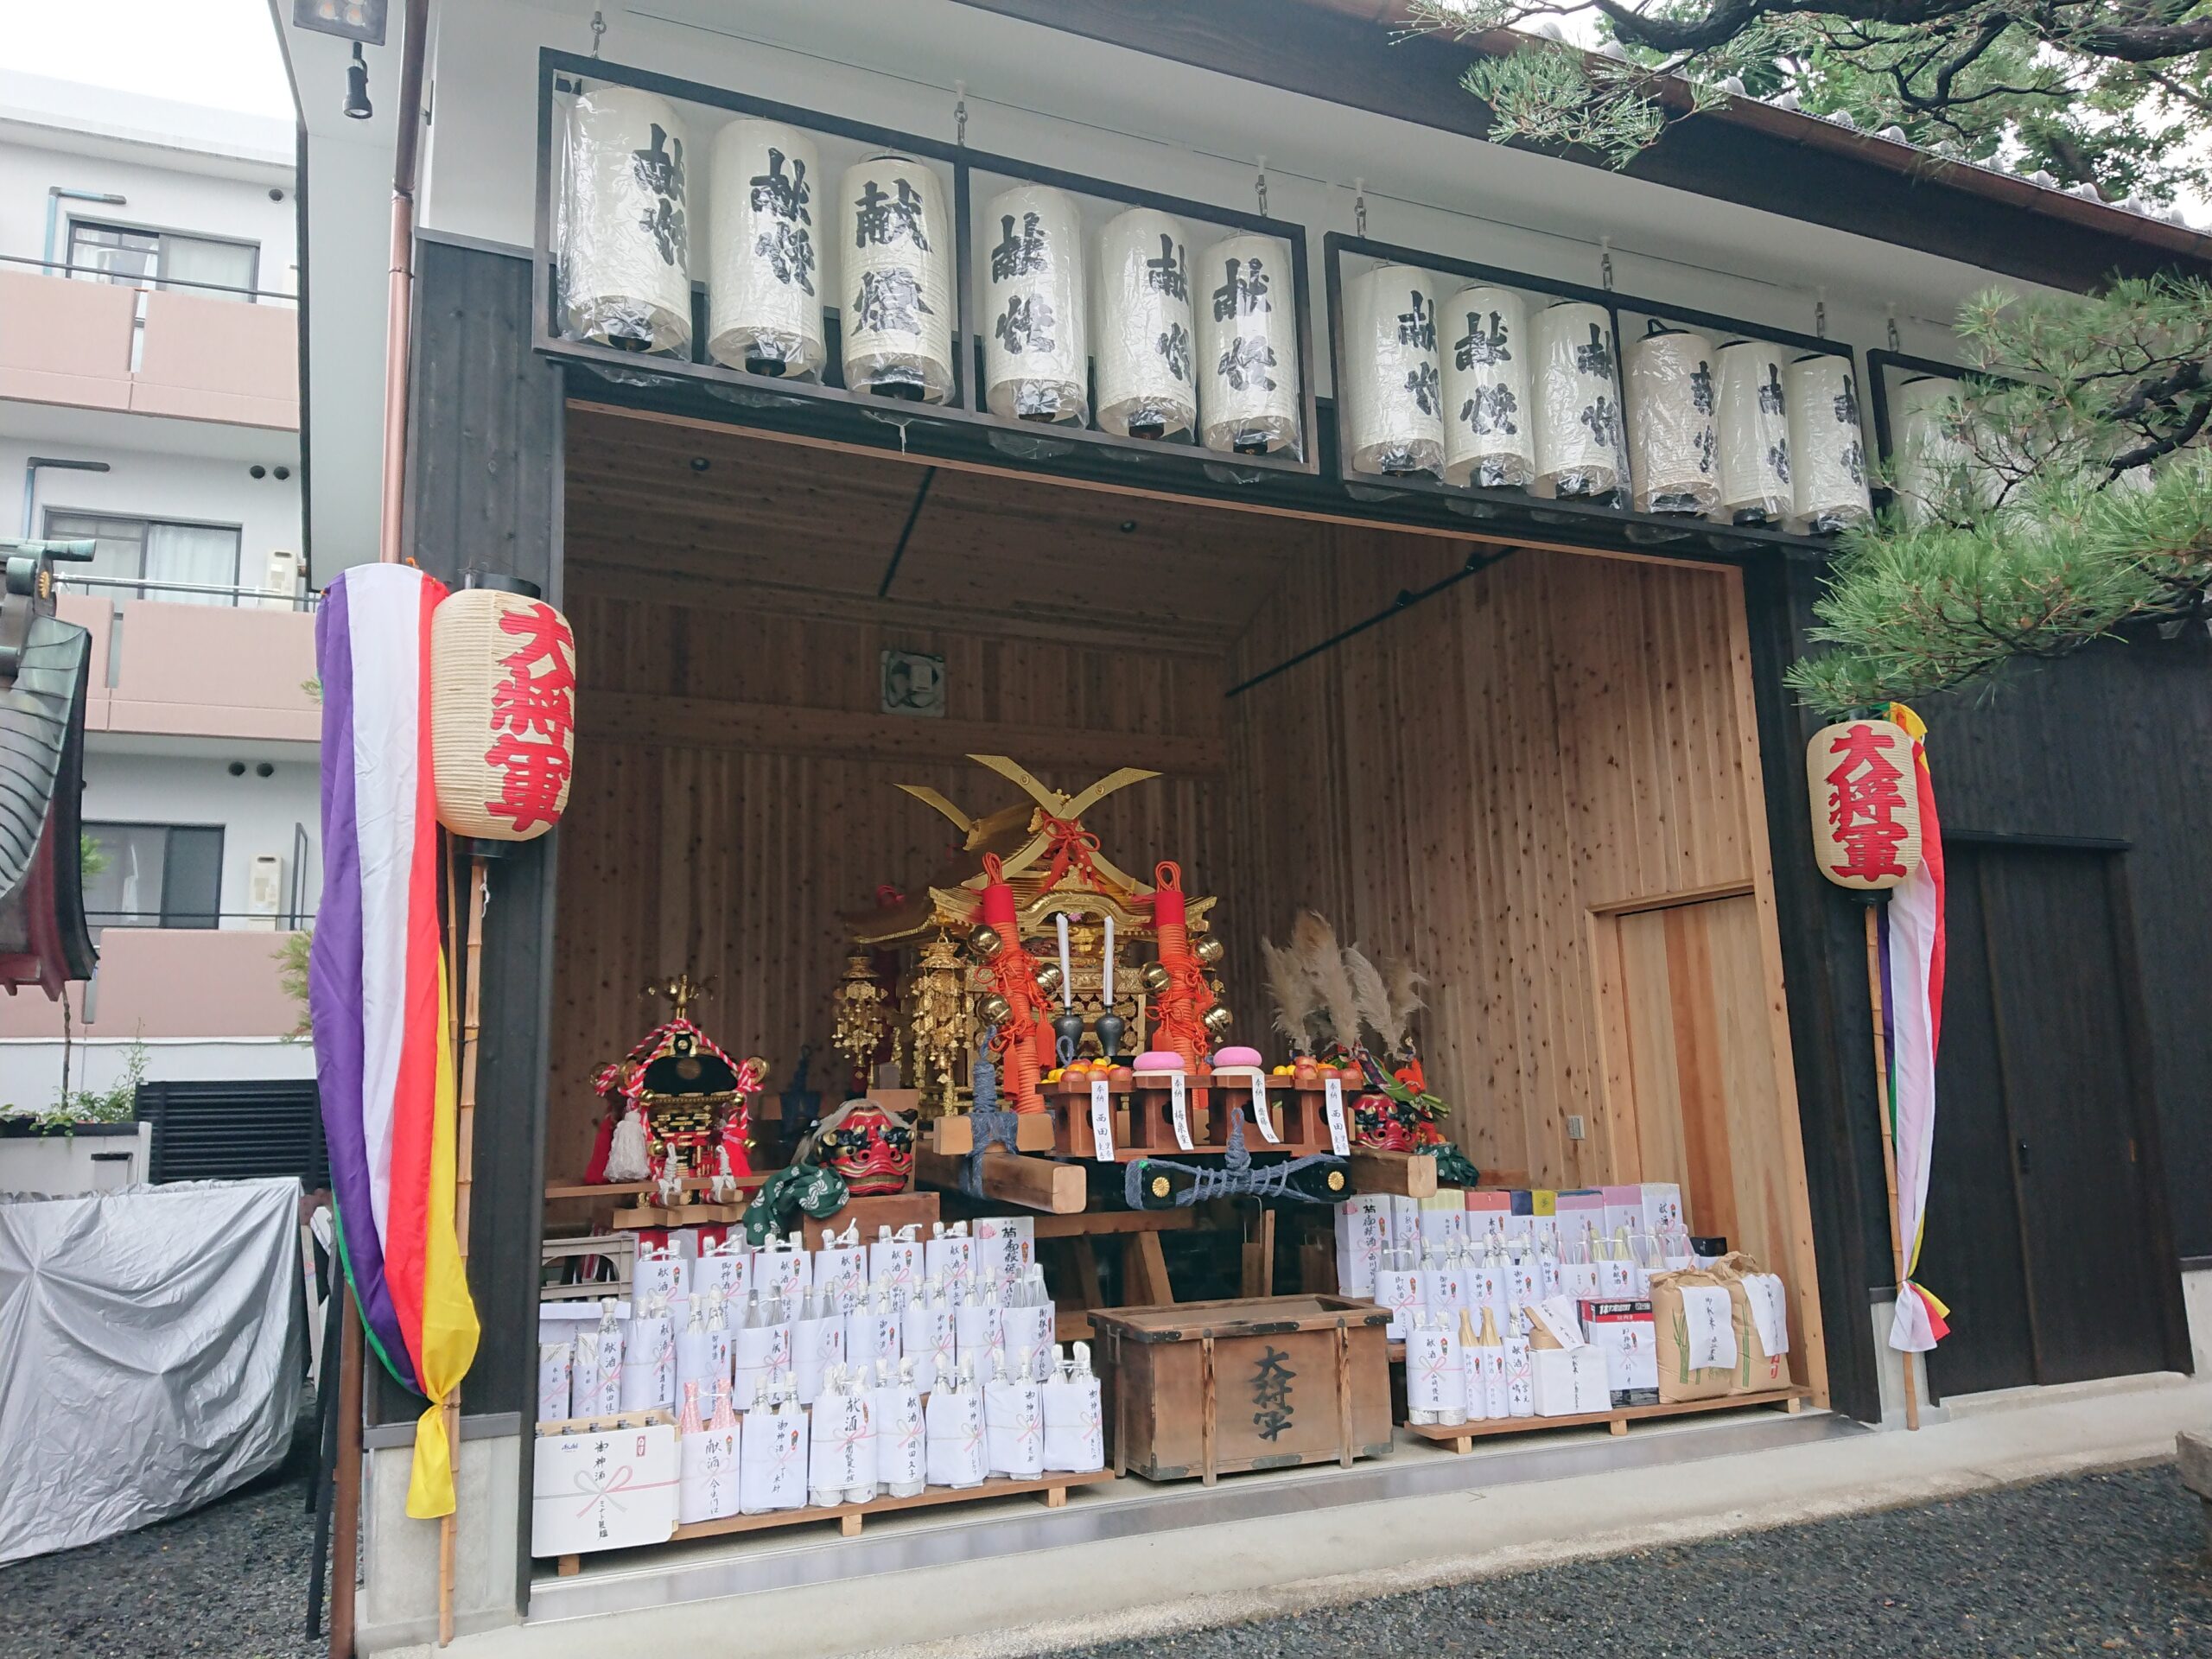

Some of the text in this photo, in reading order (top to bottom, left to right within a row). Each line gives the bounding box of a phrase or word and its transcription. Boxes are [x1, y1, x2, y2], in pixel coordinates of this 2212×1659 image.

[1096, 1113, 1109, 1136] 西田
[1332, 1109, 1343, 1131] 西田
[841, 1256, 851, 1280] 献酒
[891, 1250, 901, 1272] 献酒
[950, 1245, 960, 1268] 献酒
[658, 1268, 669, 1292] 献酒
[780, 1261, 790, 1284] 献酒
[1426, 1338, 1437, 1359] 献酒
[1512, 1345, 1522, 1368] 献酒
[605, 1342, 616, 1414] 献酒 依田佳
[845, 1398, 861, 1432] 献酒
[907, 1396, 918, 1423] 献酒
[776, 1420, 788, 1453] 御神酒
[594, 1440, 609, 1482] 御神酒
[705, 1440, 721, 1470] 献酒
